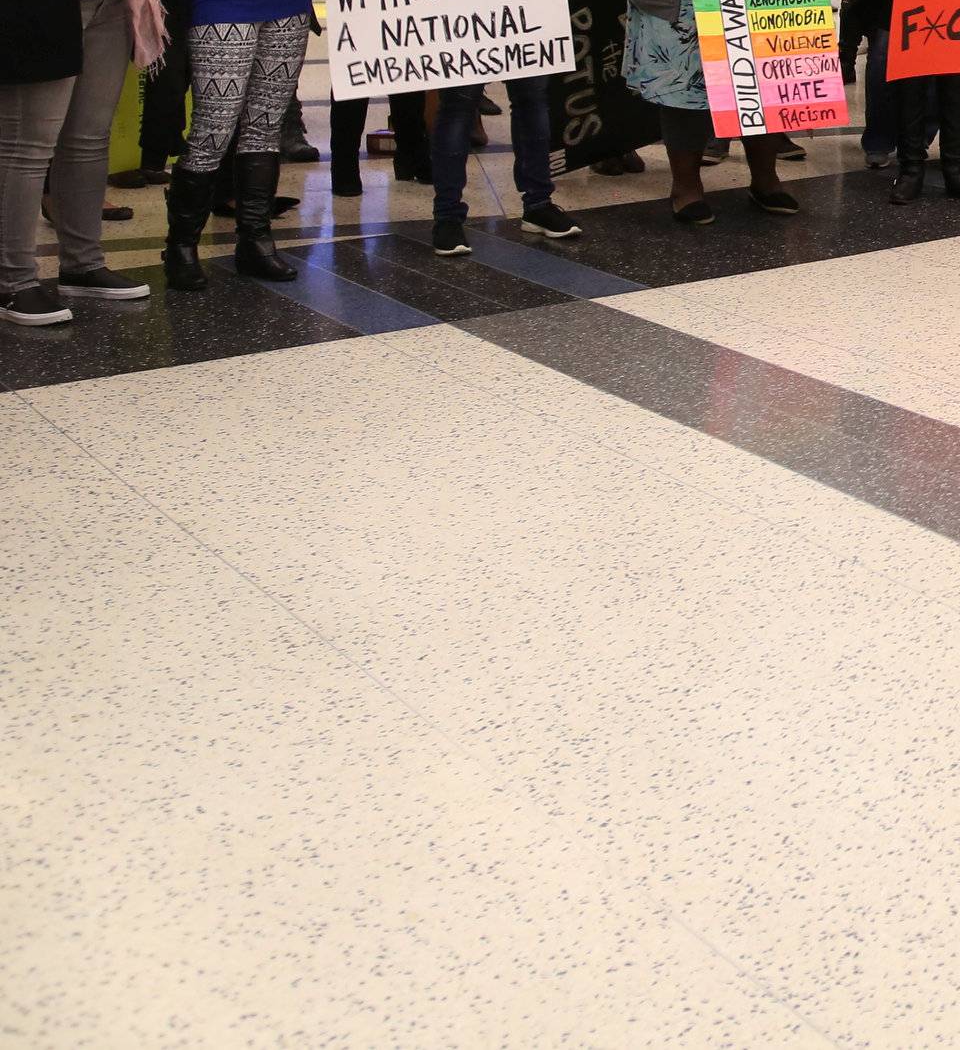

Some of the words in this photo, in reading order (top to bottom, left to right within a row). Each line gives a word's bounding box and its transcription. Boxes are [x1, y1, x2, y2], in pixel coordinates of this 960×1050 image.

[336, 22, 357, 52] A
[380, 5, 542, 51] NATIONAL
[726, 34, 750, 52] A
[346, 36, 570, 87] EMBARRASSMENT
[732, 57, 766, 128] BUILD
[777, 79, 828, 104] HATE
